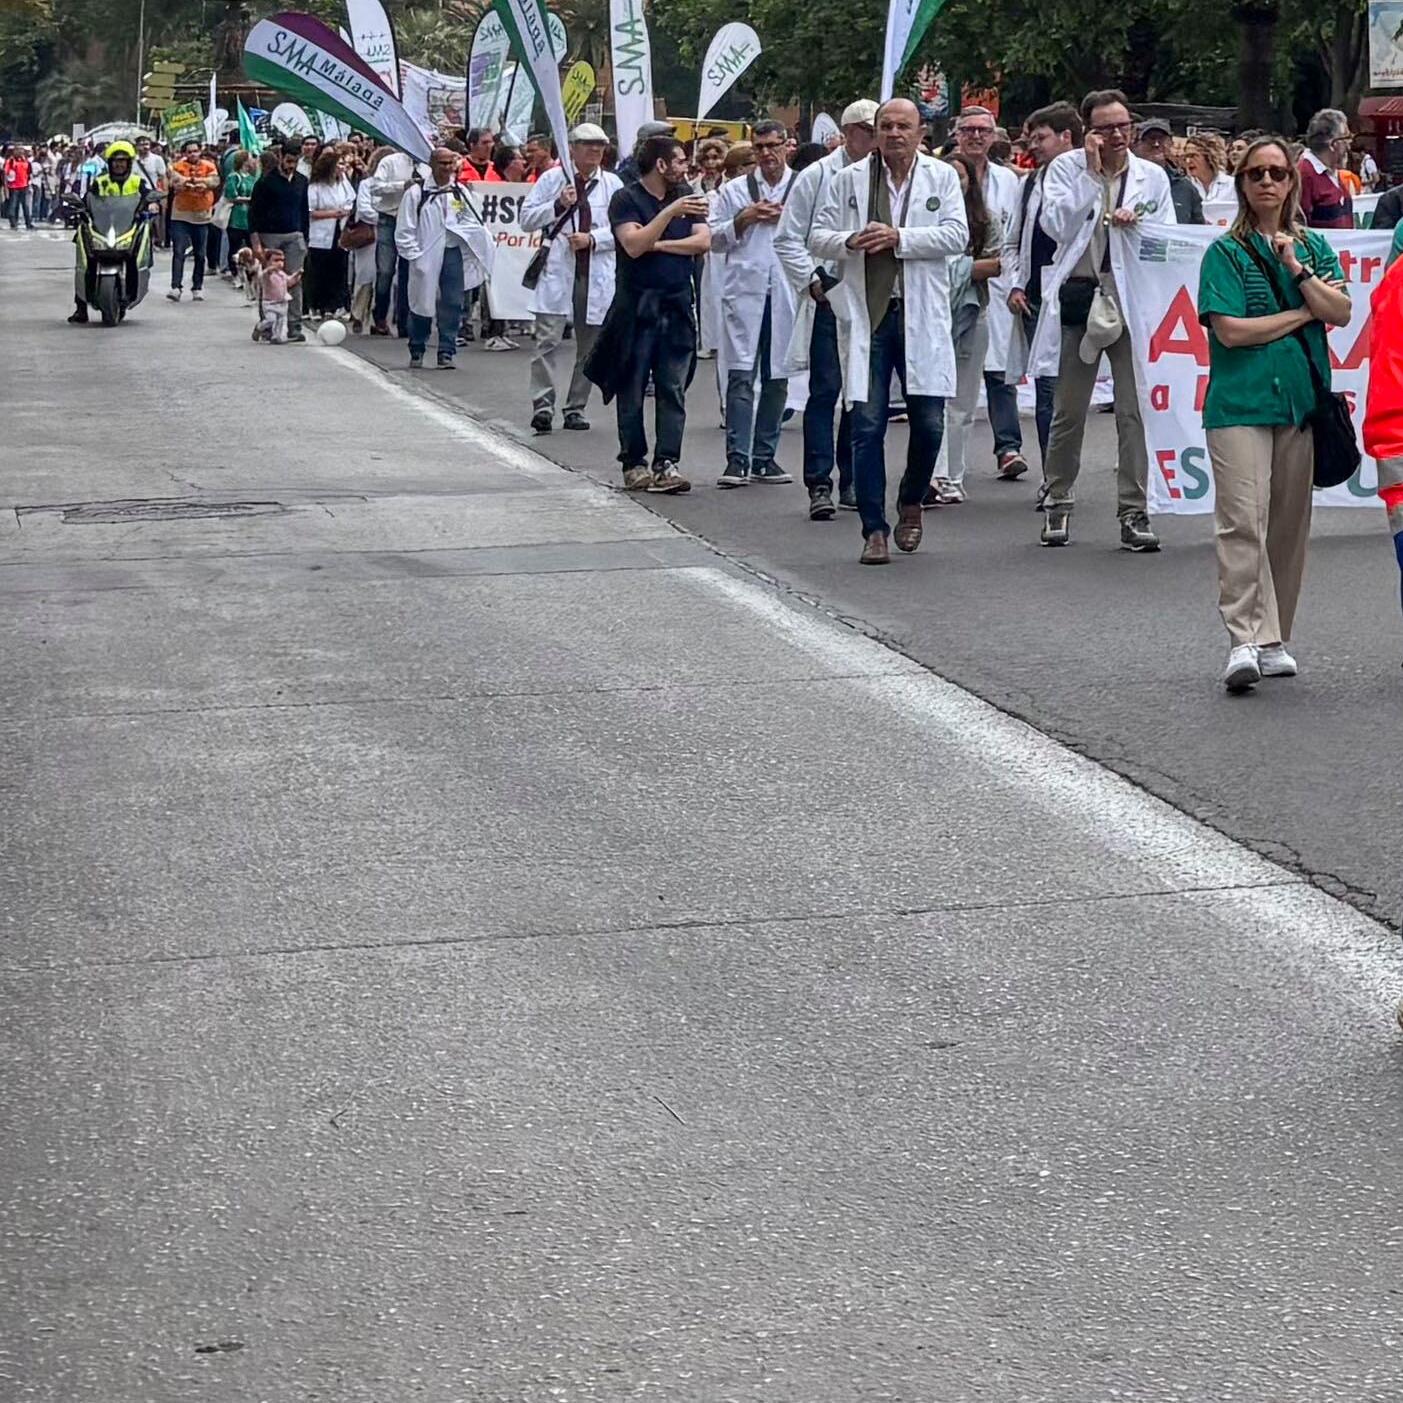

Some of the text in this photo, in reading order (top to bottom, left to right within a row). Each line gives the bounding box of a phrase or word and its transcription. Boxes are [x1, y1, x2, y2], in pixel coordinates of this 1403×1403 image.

[267, 30, 319, 76] SMA
[320, 59, 385, 110] Málaga
[496, 231, 526, 248] Por
